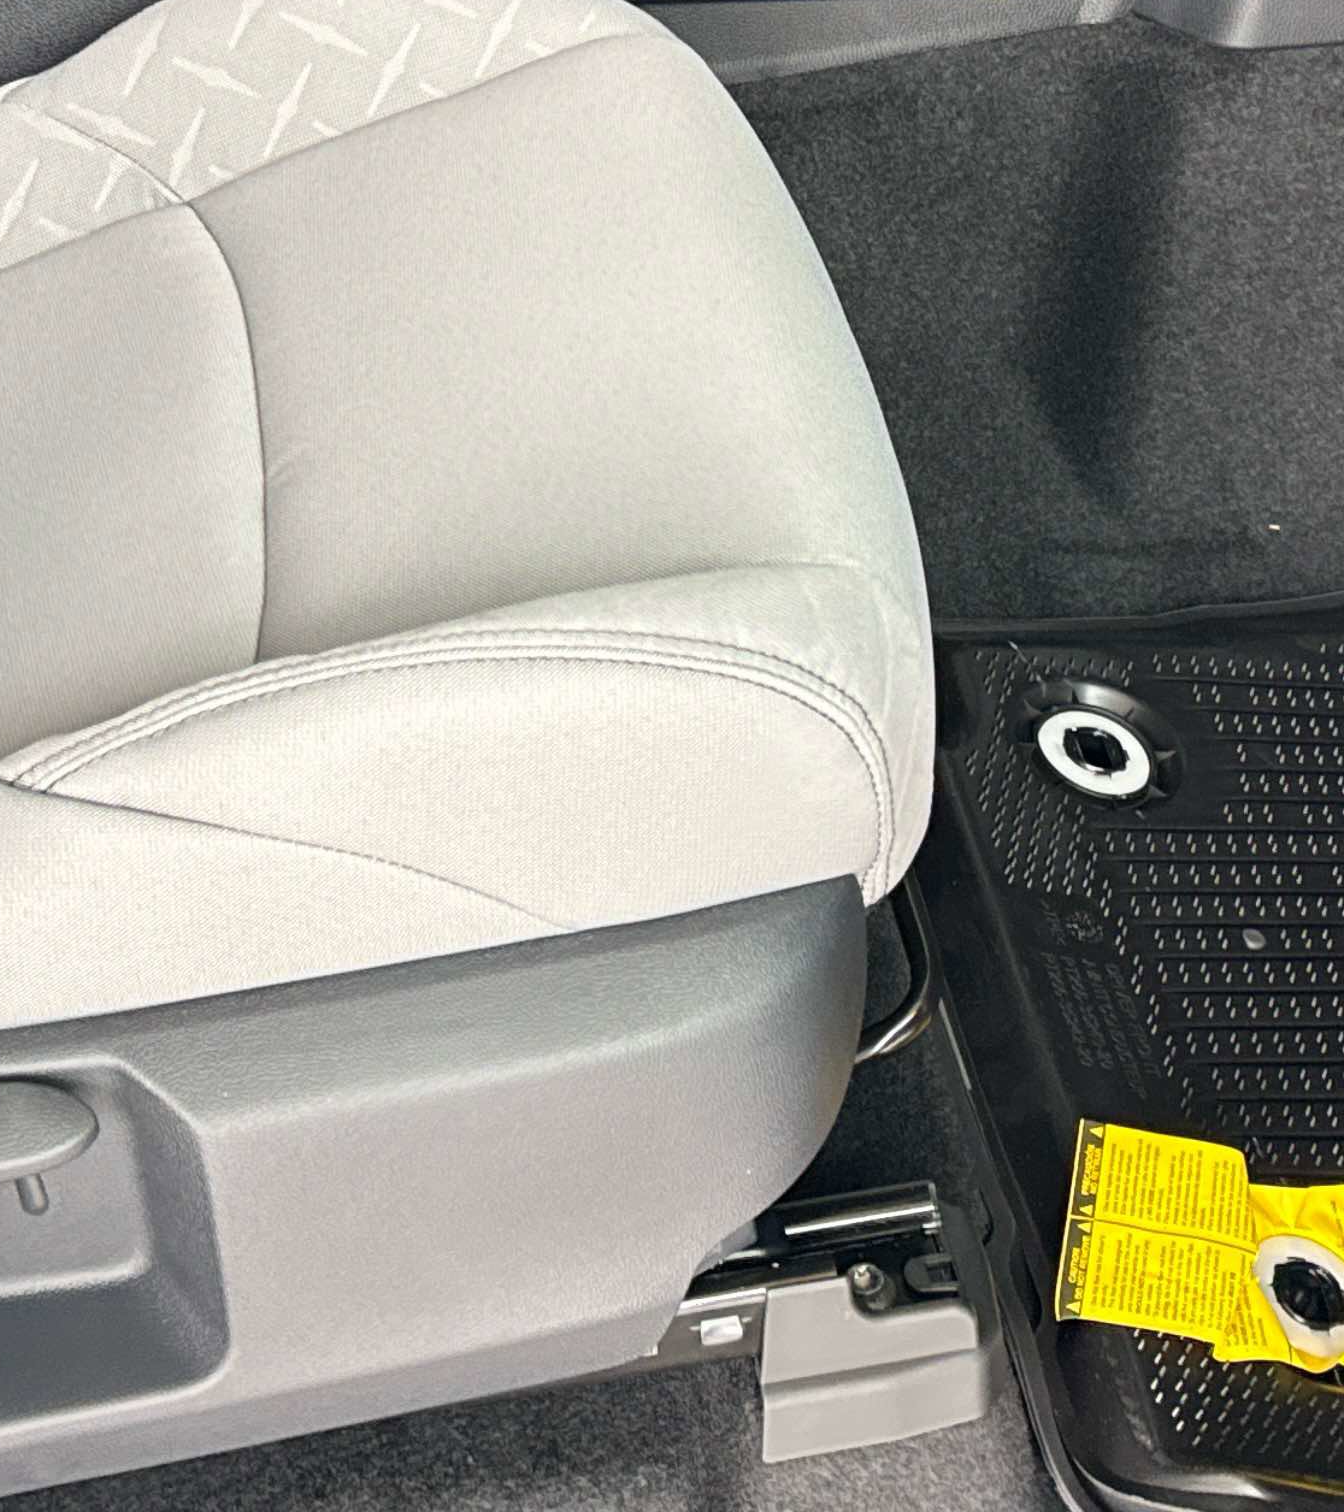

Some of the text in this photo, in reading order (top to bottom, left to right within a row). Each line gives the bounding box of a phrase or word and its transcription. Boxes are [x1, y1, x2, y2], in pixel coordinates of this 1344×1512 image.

[1067, 1247, 1080, 1283] CAUTION
[1074, 1235, 1090, 1299] DO NOT REMOVE
